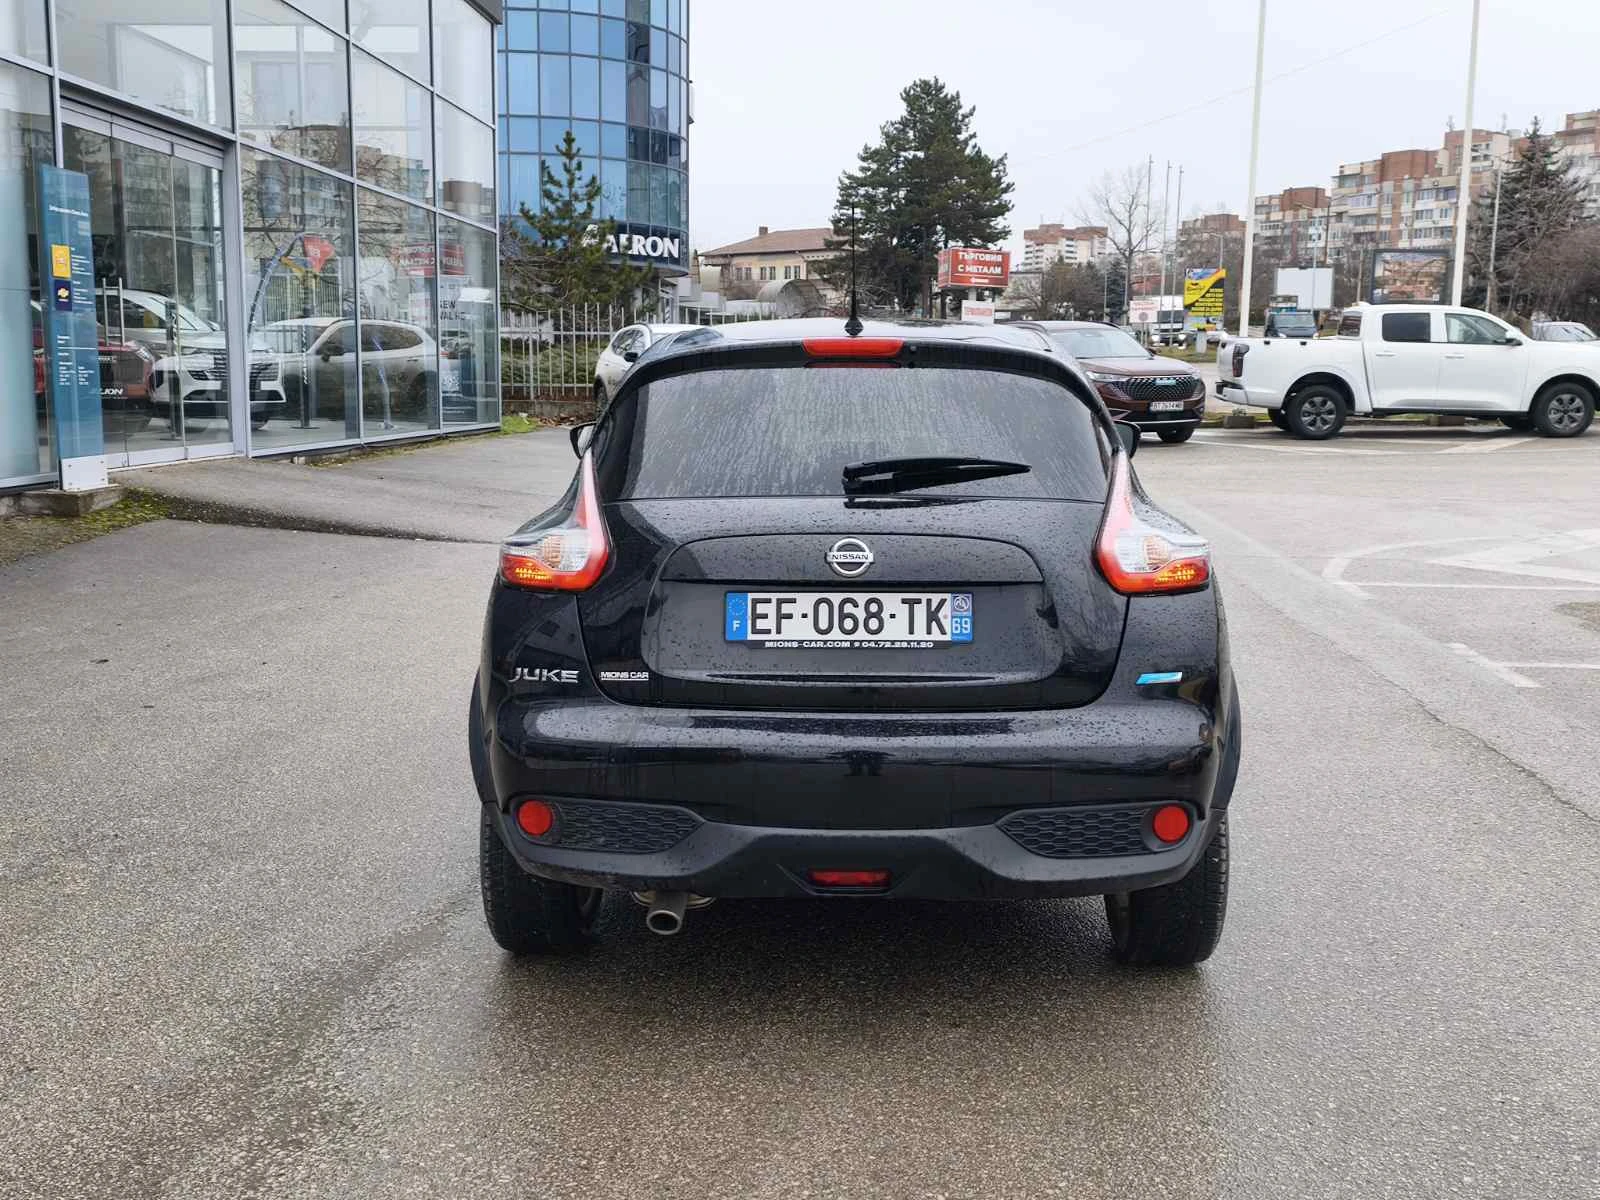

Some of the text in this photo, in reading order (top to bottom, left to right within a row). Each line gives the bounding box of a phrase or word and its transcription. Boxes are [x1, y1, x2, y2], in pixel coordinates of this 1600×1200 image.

[732, 620, 741, 632] F
[952, 617, 971, 634] 69
[765, 640, 851, 649] MIONS-CAR.COM
[508, 667, 580, 684] JUKE
[600, 671, 649, 680] MIONS CAR
